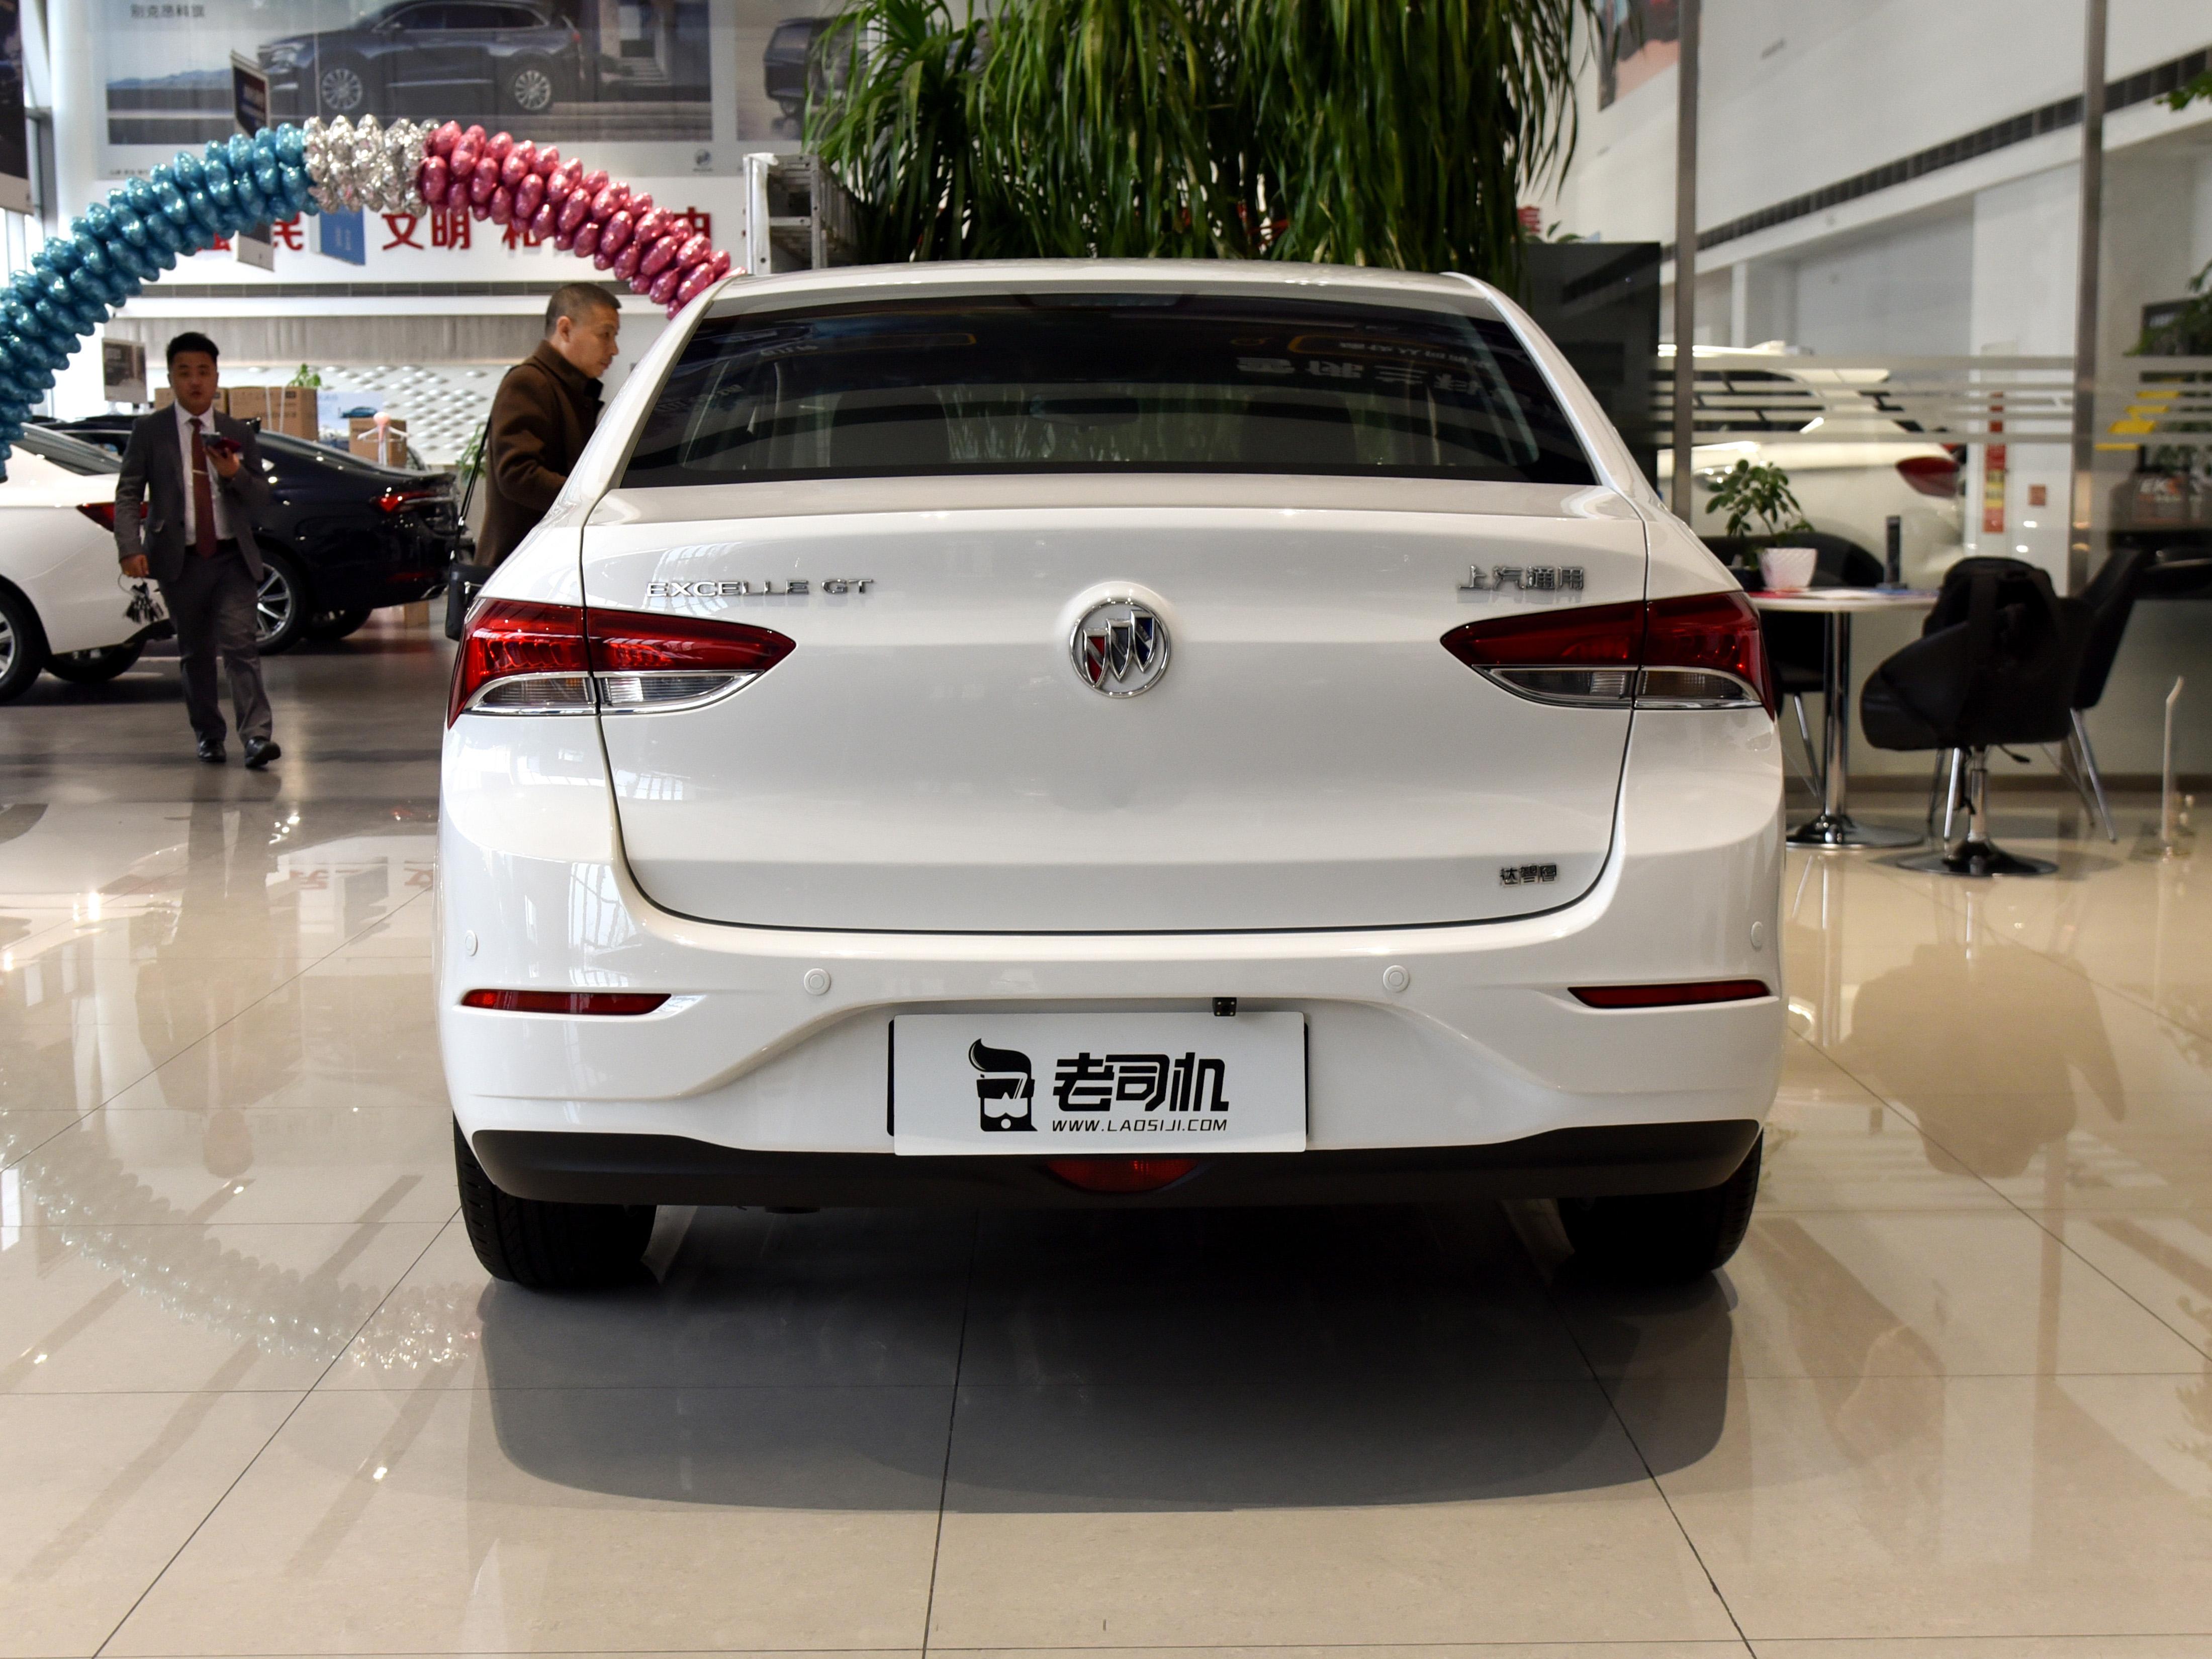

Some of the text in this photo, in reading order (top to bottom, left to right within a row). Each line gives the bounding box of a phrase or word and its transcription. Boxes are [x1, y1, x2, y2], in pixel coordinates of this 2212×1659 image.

[382, 210, 471, 250] 文明
[647, 578, 875, 598] EXCELLE GT
[1459, 565, 1584, 591] 上汽通用
[1053, 1052, 1229, 1112] 老司机
[1052, 1119, 1228, 1132] WWW.LAOSIJI.COM
